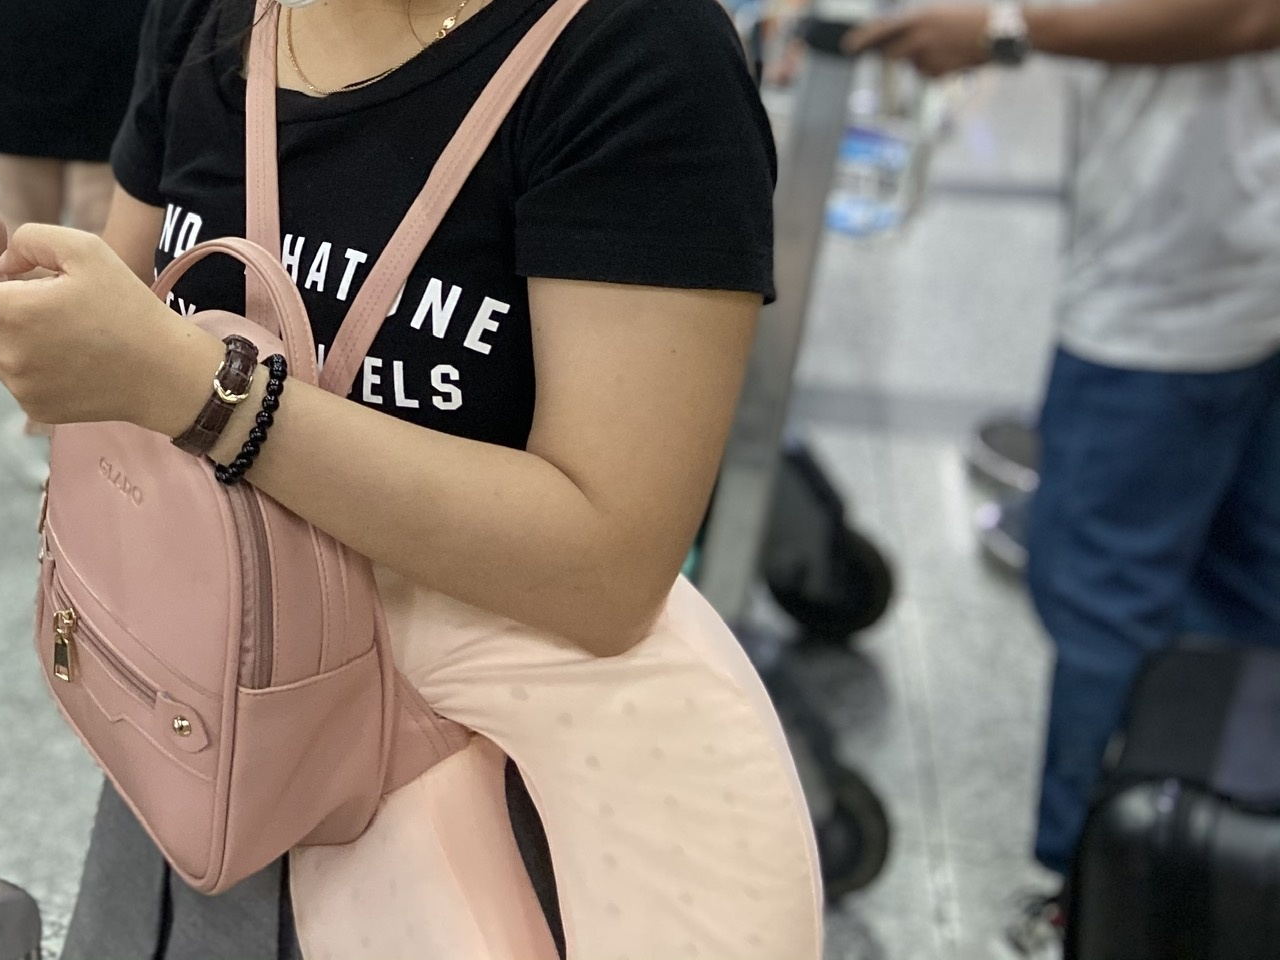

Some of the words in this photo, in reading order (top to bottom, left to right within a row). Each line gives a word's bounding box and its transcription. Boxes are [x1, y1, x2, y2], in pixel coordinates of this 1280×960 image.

[260, 233, 368, 301] HAT
[386, 276, 511, 355] NE
[317, 343, 463, 411] ELS
